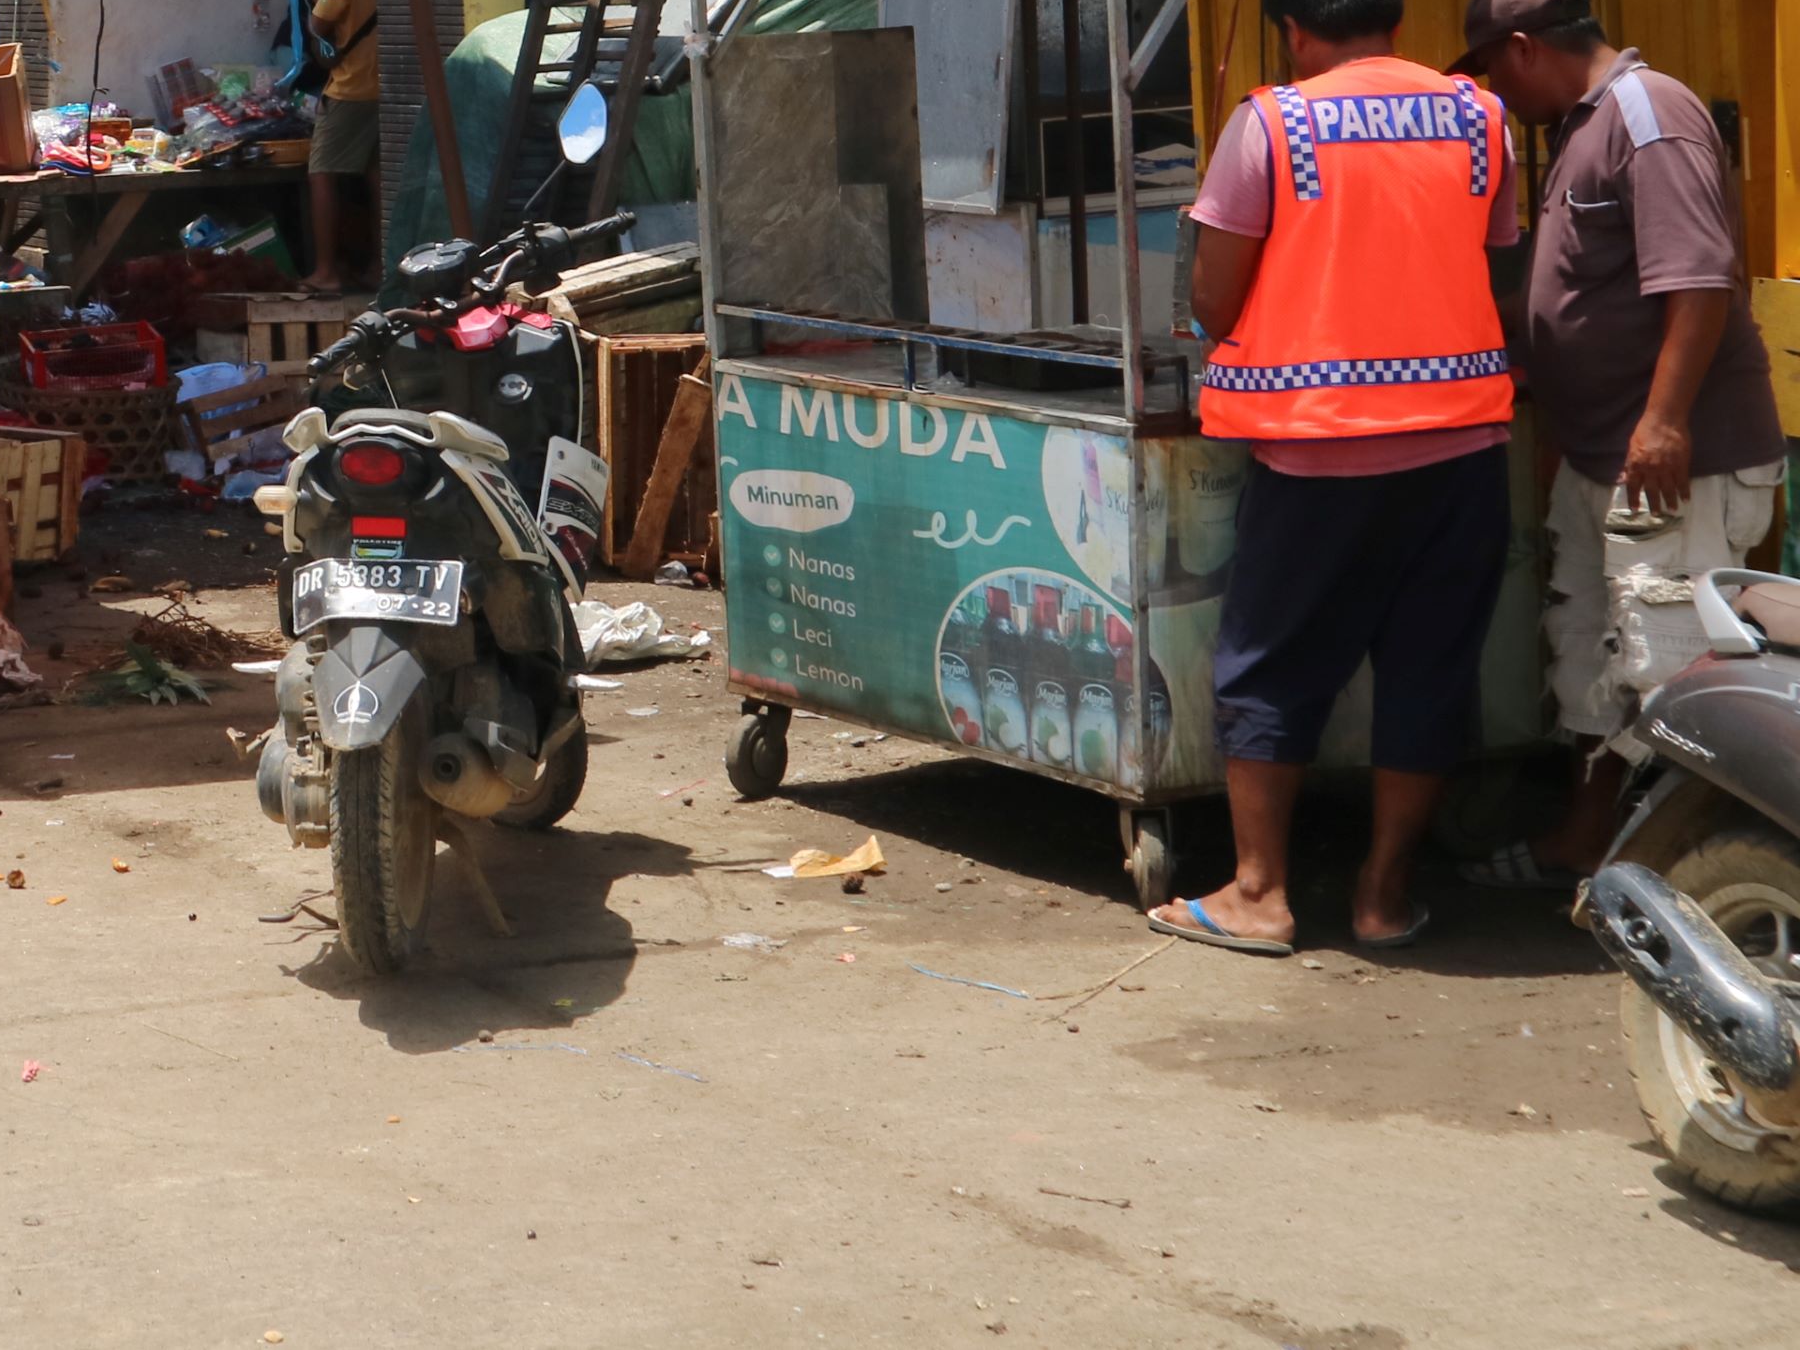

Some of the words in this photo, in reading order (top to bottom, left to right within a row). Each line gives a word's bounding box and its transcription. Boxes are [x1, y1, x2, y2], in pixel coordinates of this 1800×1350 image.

[1312, 95, 1462, 140] PARKIR
[779, 385, 1008, 470] MUDA
[747, 485, 840, 512] Minuman
[297, 566, 325, 597] DR
[335, 564, 402, 587] 5383
[416, 564, 449, 590] TV
[789, 547, 856, 581] Nanas
[790, 584, 857, 618] Nanas
[793, 619, 832, 648] Leci
[795, 653, 864, 693] Lemon
